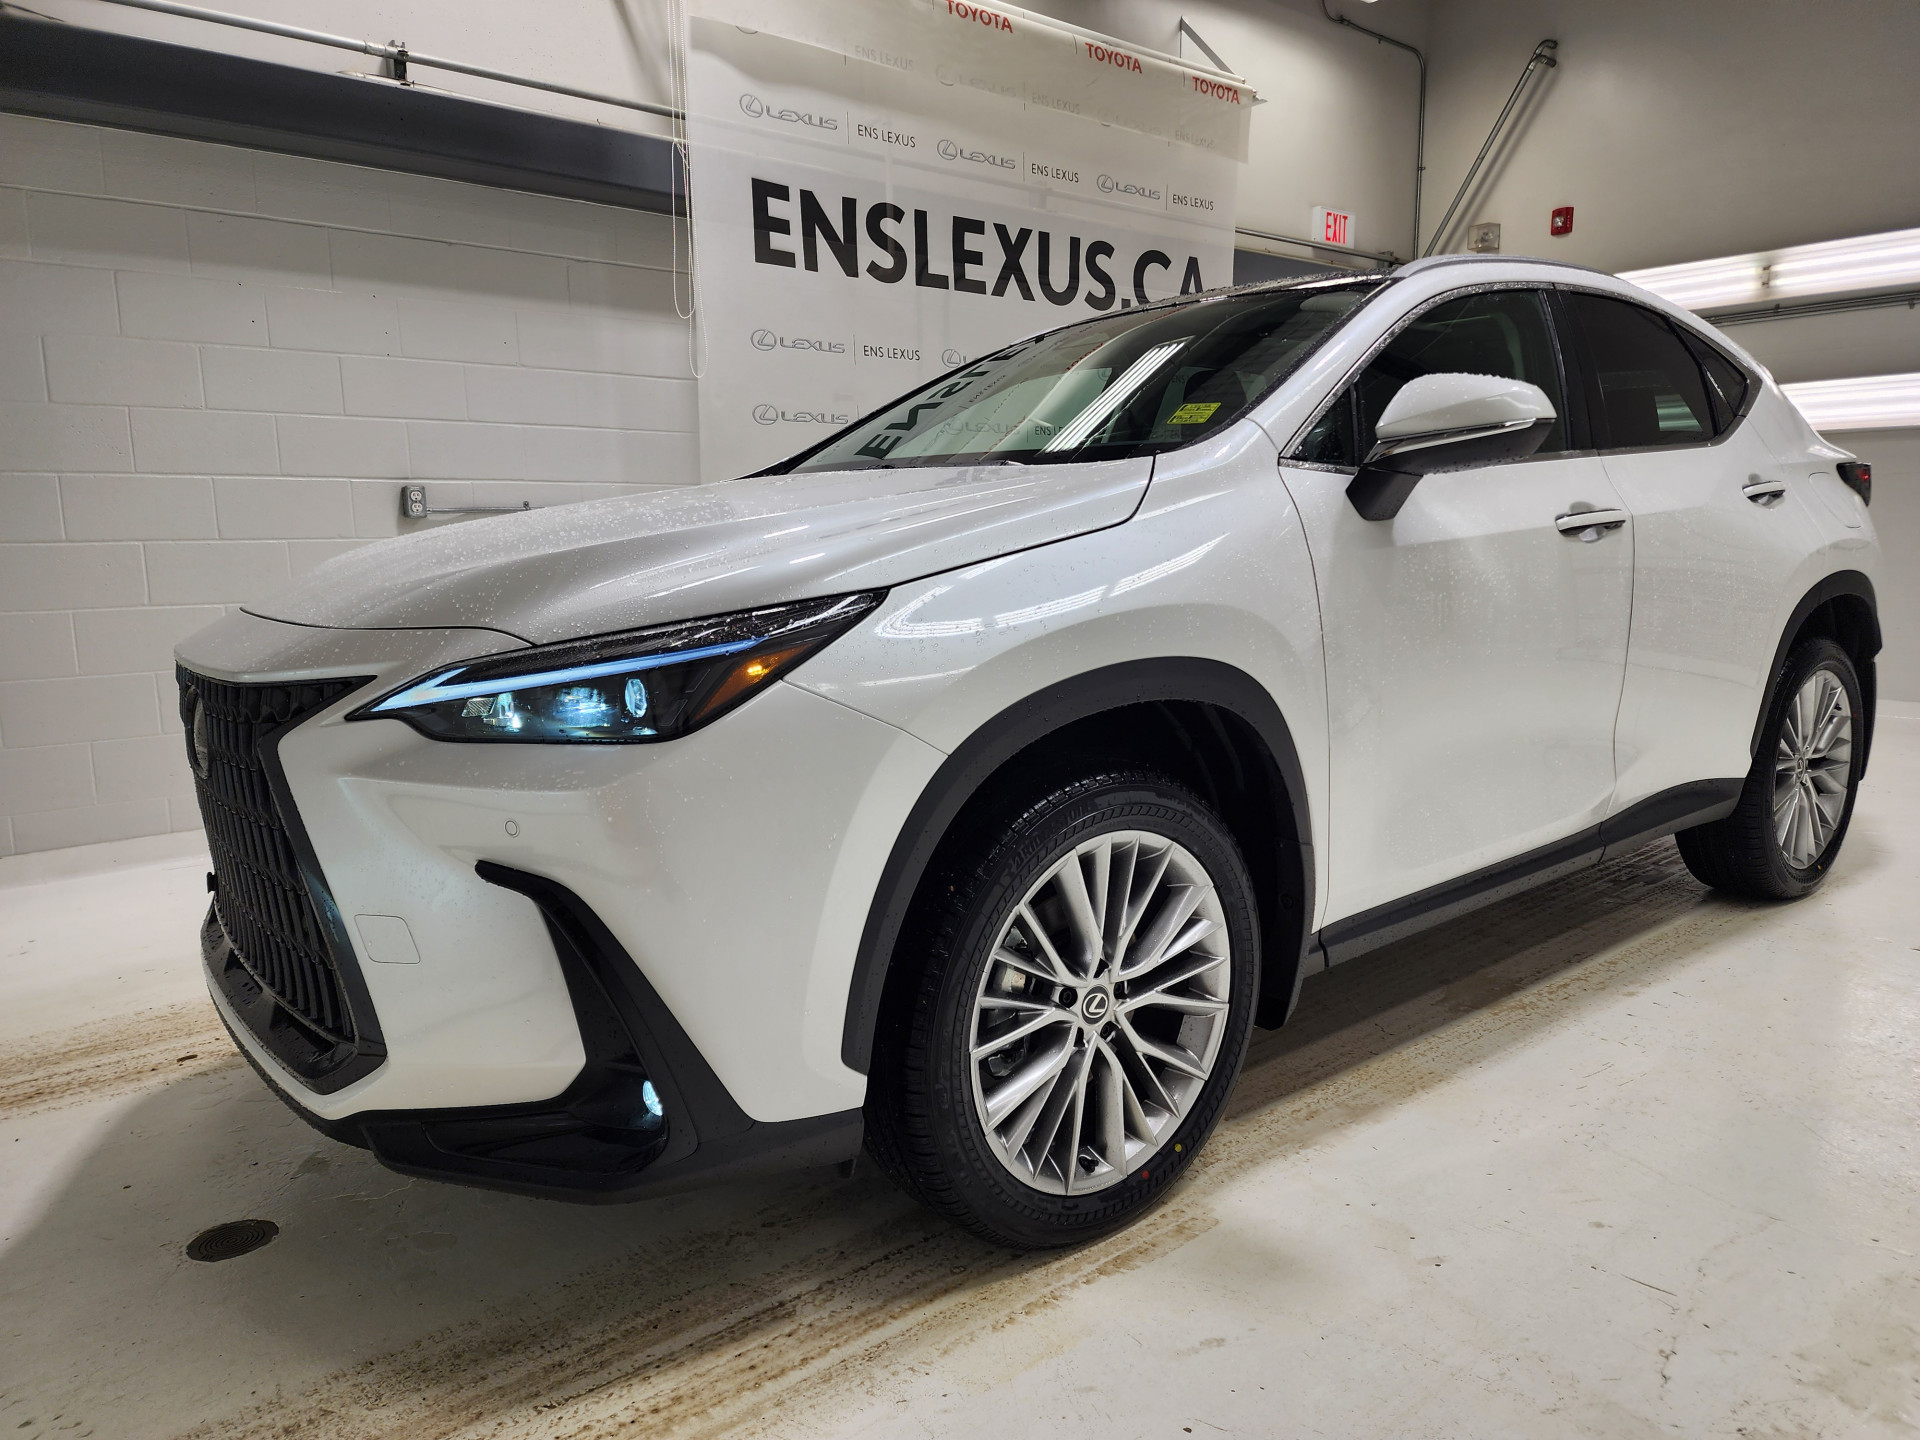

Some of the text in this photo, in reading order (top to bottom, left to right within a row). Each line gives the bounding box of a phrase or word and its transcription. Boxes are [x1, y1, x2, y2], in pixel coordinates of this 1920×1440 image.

[945, 0, 1013, 34] TOYOTA
[880, 50, 914, 72] LEXUS
[1085, 42, 1143, 74] TOYOTA
[1192, 76, 1241, 105] TOYOTA
[766, 104, 916, 148] LEXUS ENS LEXUS
[959, 148, 1079, 183] LEXUS ENS LEXUS
[1115, 181, 1214, 211] LEXUS ENS LEXUS
[1325, 211, 1348, 245] EXIT
[750, 177, 1204, 312] ENSLEXUS.CA
[779, 336, 921, 361] LEXUS ENS LEXUS
[780, 410, 849, 425] LEXUS
[1034, 425, 1051, 436] ENS
